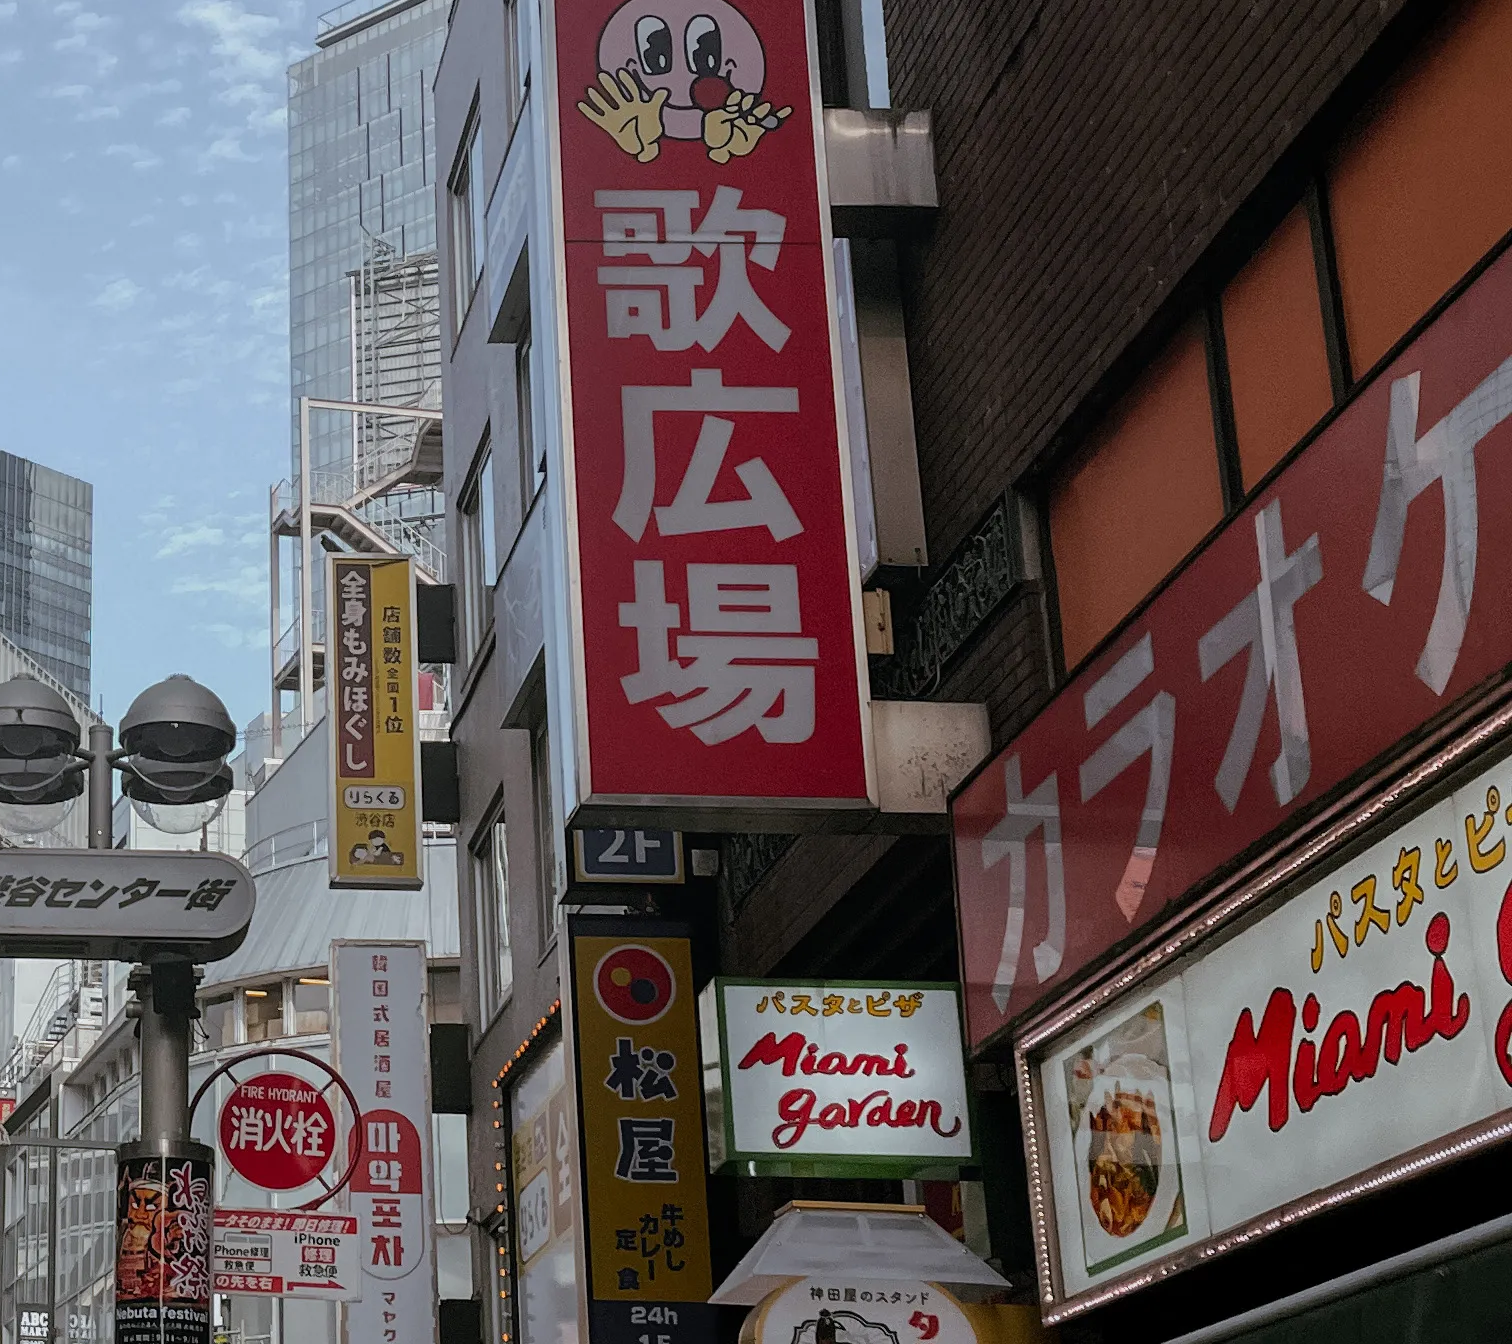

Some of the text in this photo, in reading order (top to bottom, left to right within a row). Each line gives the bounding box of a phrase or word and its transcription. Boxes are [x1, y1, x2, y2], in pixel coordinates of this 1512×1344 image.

[593, 184, 820, 748] 歌広場
[339, 570, 368, 771] 全身もみほぐし
[983, 356, 1512, 1014] カラオケ
[349, 790, 400, 805] りらくる
[355, 813, 395, 828] 渋谷店
[1312, 785, 1512, 972] パスタとピ
[756, 992, 924, 1017] パスタとピザ
[1209, 912, 1470, 1143] Miami
[738, 1031, 915, 1079] Miami
[241, 1086, 318, 1104] FIRE HYDRANT
[605, 1037, 679, 1183] 松屋
[230, 1106, 328, 1157] 消火栓
[367, 1122, 404, 1267] 마약포차
[214, 1215, 289, 1230] ータそのまま!
[294, 1233, 341, 1246] iPhone
[640, 1214, 659, 1280] カレー
[660, 1204, 685, 1272] 牛めし
[214, 1245, 269, 1258] Phone修理
[305, 1248, 334, 1262] 修理
[615, 1230, 640, 1290] 定食
[224, 1260, 255, 1271] 救急便
[298, 1264, 337, 1278] 救急便
[217, 1276, 273, 1290] の先を右
[810, 1286, 930, 1306] 神田屋のスタンド
[21, 1312, 48, 1326] ABC
[160, 1306, 208, 1323] festival
[631, 1307, 678, 1325] 24h
[20, 1327, 49, 1337] MART
